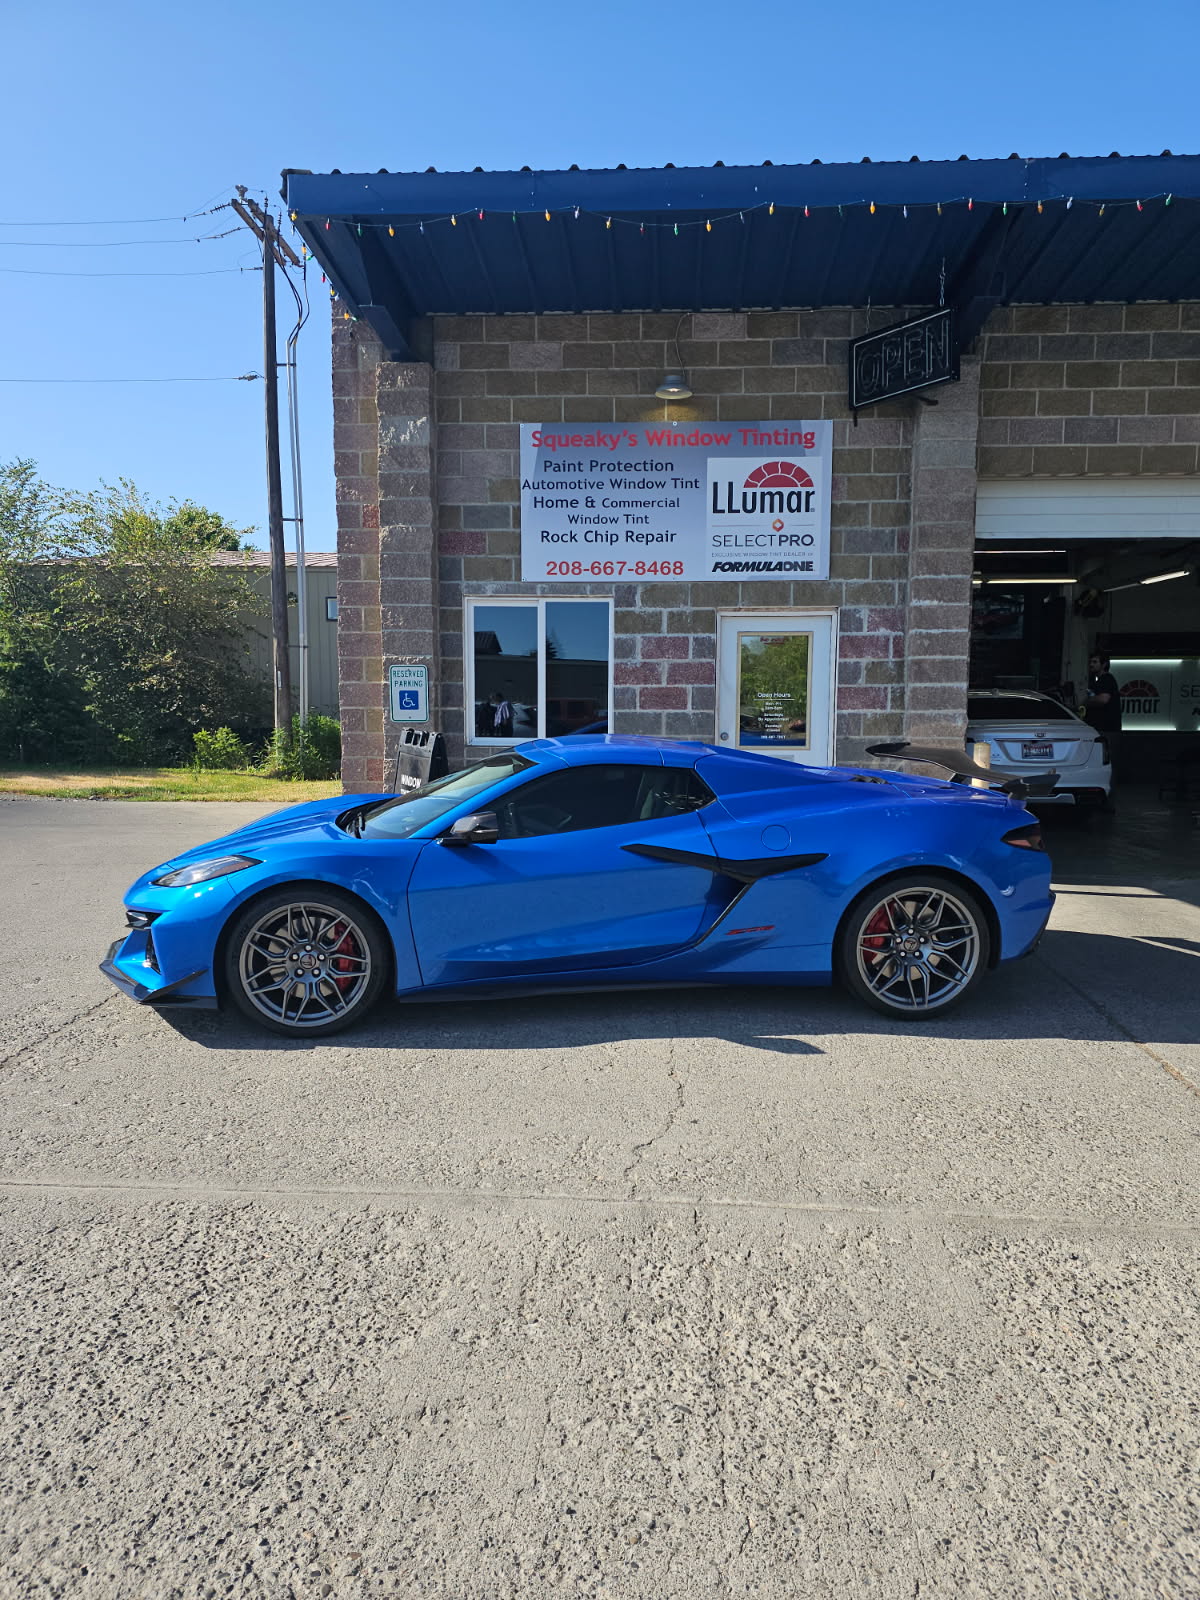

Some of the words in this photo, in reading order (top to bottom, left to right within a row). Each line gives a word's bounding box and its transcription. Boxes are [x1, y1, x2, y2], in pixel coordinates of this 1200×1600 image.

[857, 318, 949, 396] OPEN
[531, 429, 638, 451] Squeaky's
[645, 428, 732, 447] Window
[738, 428, 816, 449] Tinting
[544, 460, 584, 473] Paint
[589, 459, 674, 473] Protection
[521, 478, 605, 490] Automotive
[609, 477, 667, 490] Window
[671, 477, 700, 489] Tint
[533, 496, 579, 509] Home
[585, 496, 596, 509] &
[602, 497, 680, 508] Commercial
[712, 481, 815, 514] LLumar
[568, 514, 619, 525] Window
[623, 513, 650, 525] Tint
[541, 530, 578, 543] Rock
[584, 530, 619, 546] Chip
[625, 530, 677, 546] Repair
[546, 560, 684, 576] 208-667-8468
[392, 670, 424, 678] RESERVED
[394, 680, 423, 688] PARKING
